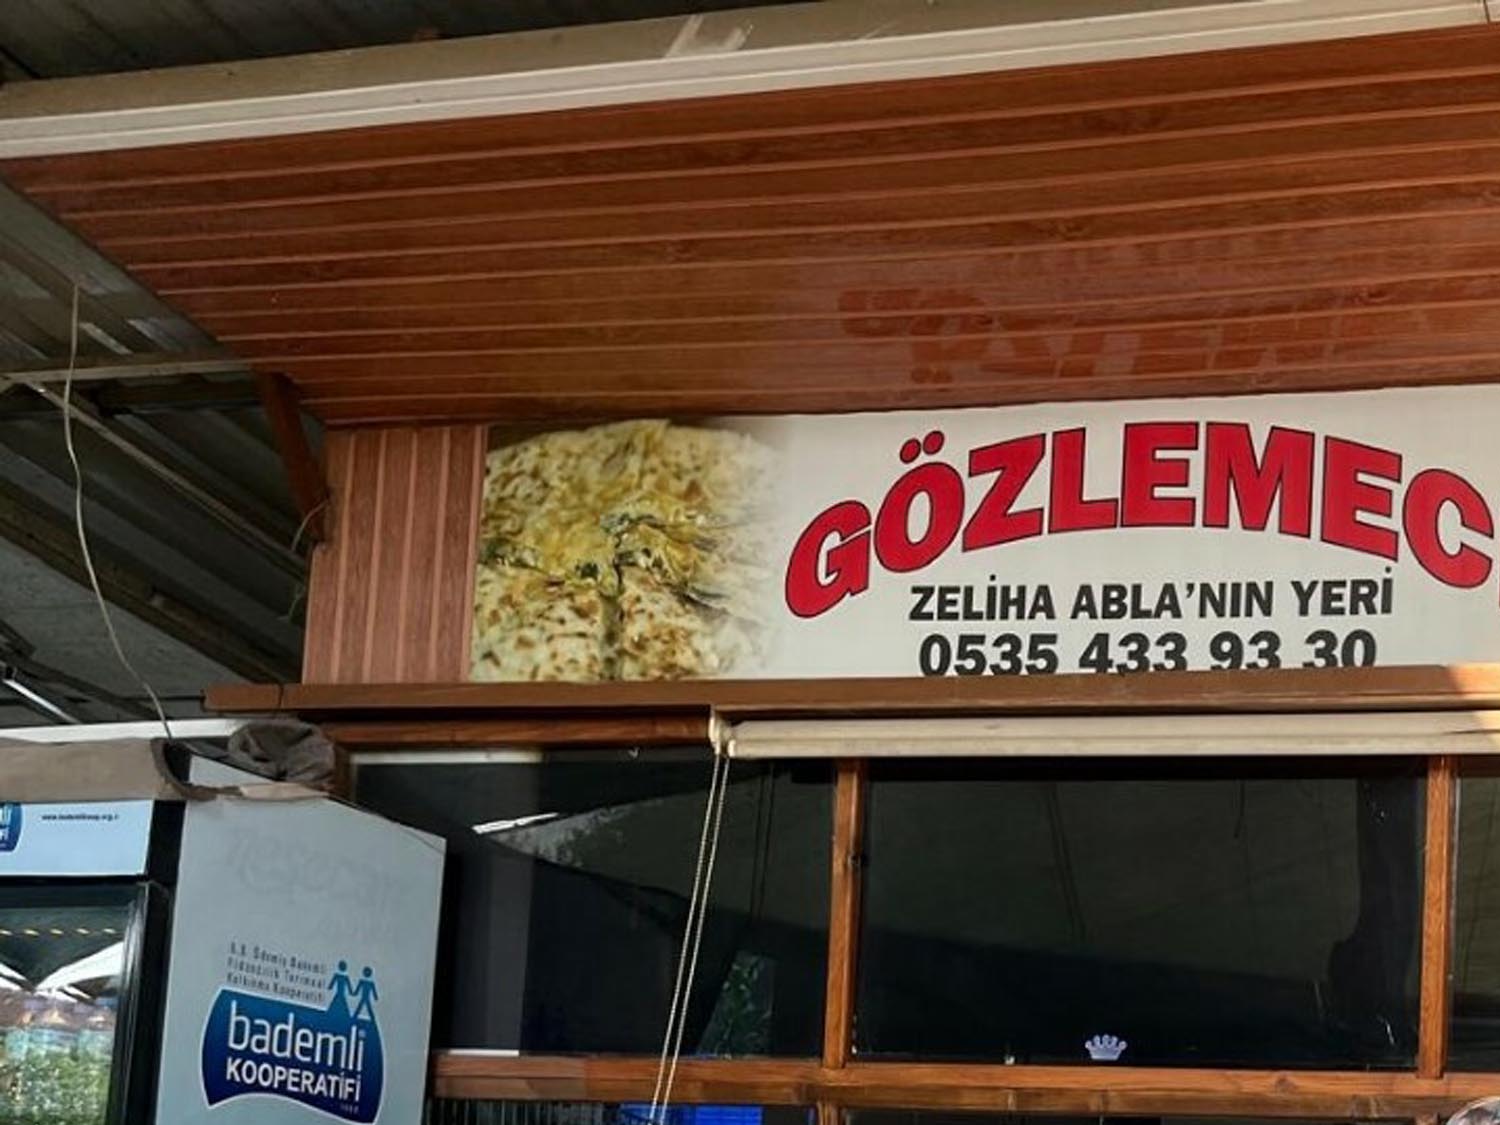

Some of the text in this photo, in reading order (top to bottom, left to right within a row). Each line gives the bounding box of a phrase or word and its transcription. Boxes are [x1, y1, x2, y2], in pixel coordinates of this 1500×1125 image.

[909, 574, 1056, 622] ZELİHA
[1291, 565, 1394, 617] YERİ
[919, 629, 1377, 677] 0535 433 93 30
[227, 999, 367, 1072] bademli
[226, 1057, 362, 1103] KOOPERATİFİ
